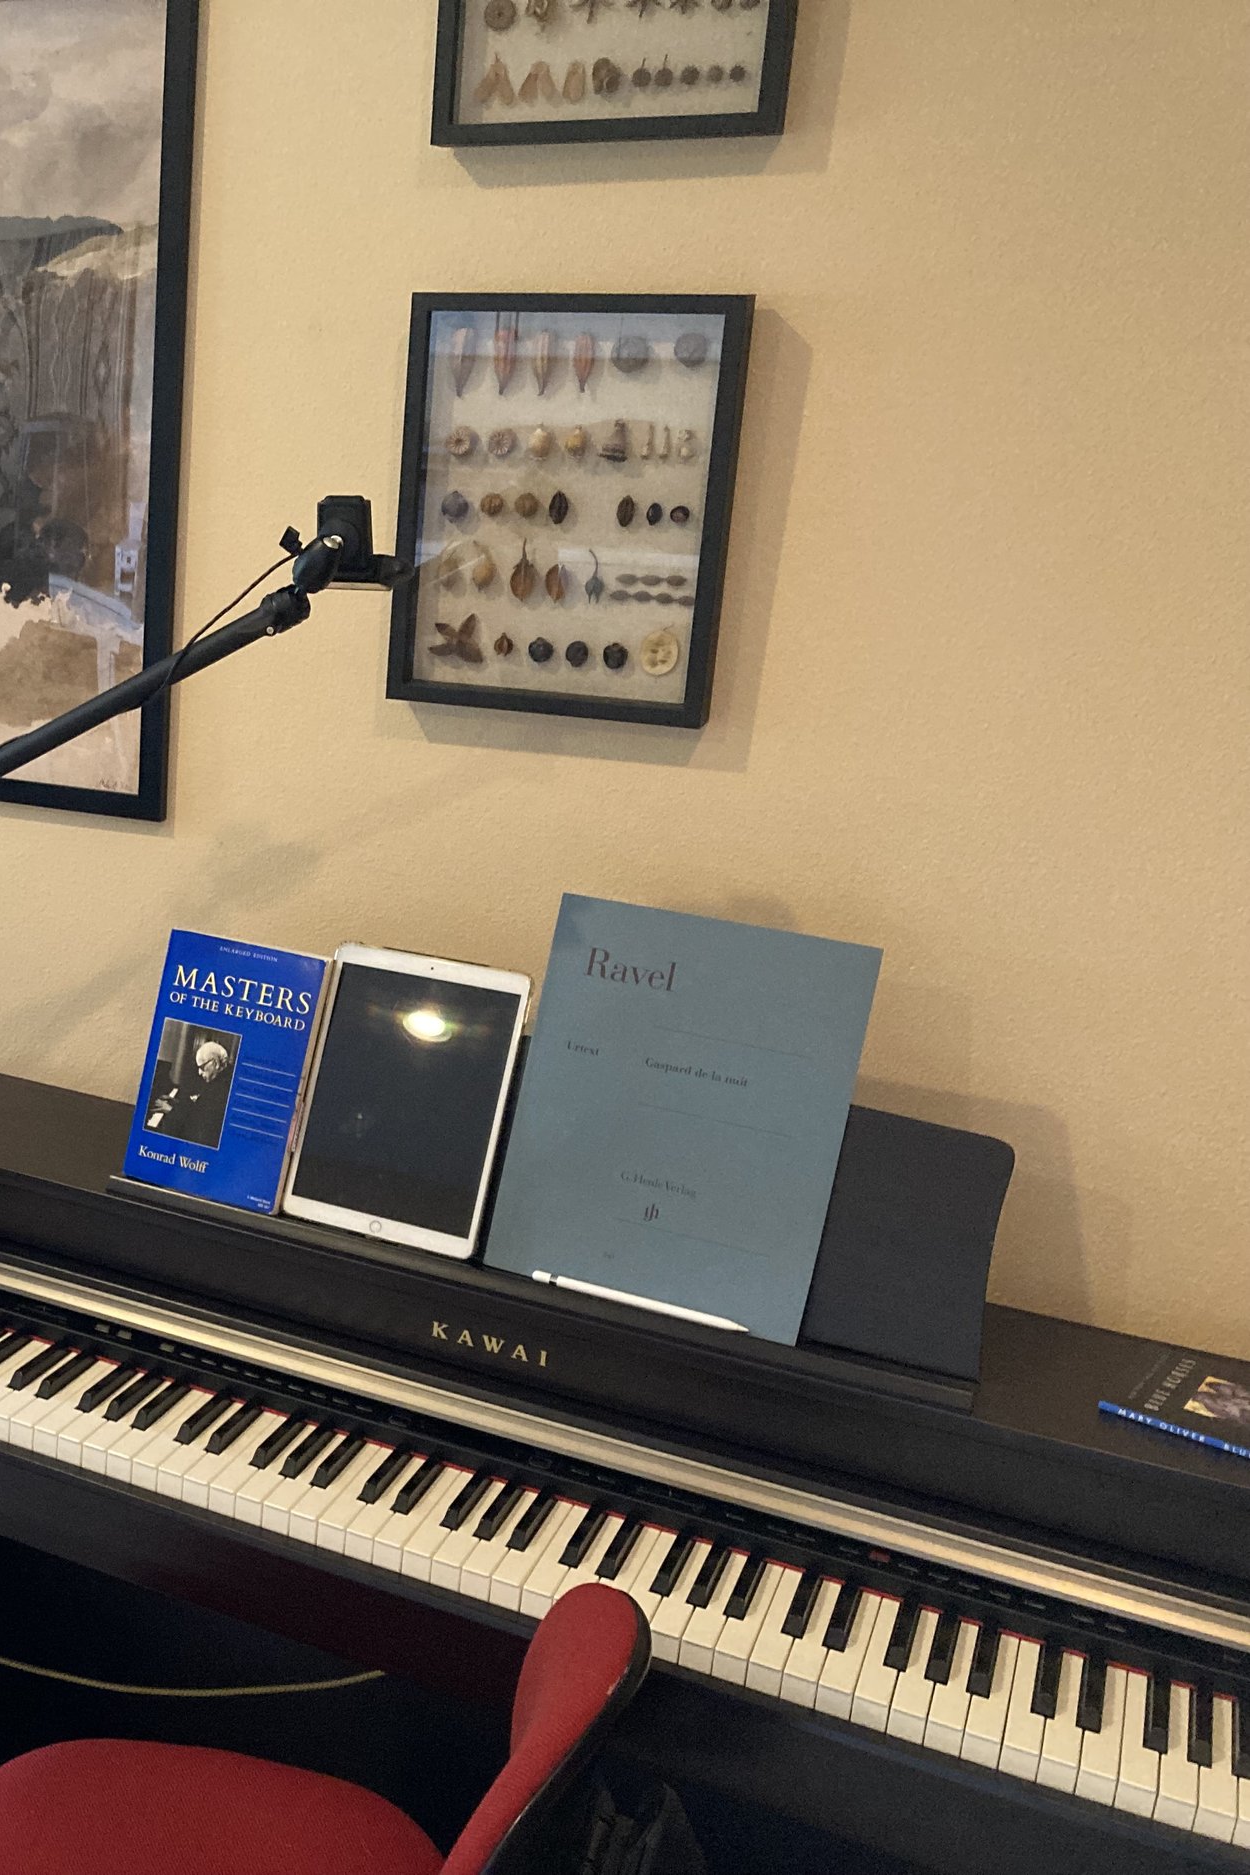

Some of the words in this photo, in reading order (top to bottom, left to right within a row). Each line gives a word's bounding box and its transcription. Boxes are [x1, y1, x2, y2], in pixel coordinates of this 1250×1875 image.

[252, 952, 279, 963] EDITION
[584, 947, 677, 992] Ravel
[173, 964, 312, 1015] MASTERS
[169, 991, 188, 1005] OF
[191, 995, 220, 1013] THE
[224, 1003, 306, 1032] KEYBOARD
[566, 1039, 600, 1057] Urtext
[644, 1056, 693, 1076] Gaspard
[694, 1068, 709, 1080] de
[711, 1070, 722, 1083] la
[724, 1075, 749, 1088] nuit
[138, 1144, 176, 1165] Konrad
[179, 1155, 210, 1174] Wolff
[431, 1320, 548, 1368] KAWAI
[1117, 1407, 1153, 1425] MARY
[1159, 1421, 1206, 1443] OLIVER
[1223, 1442, 1250, 1460] BLU
